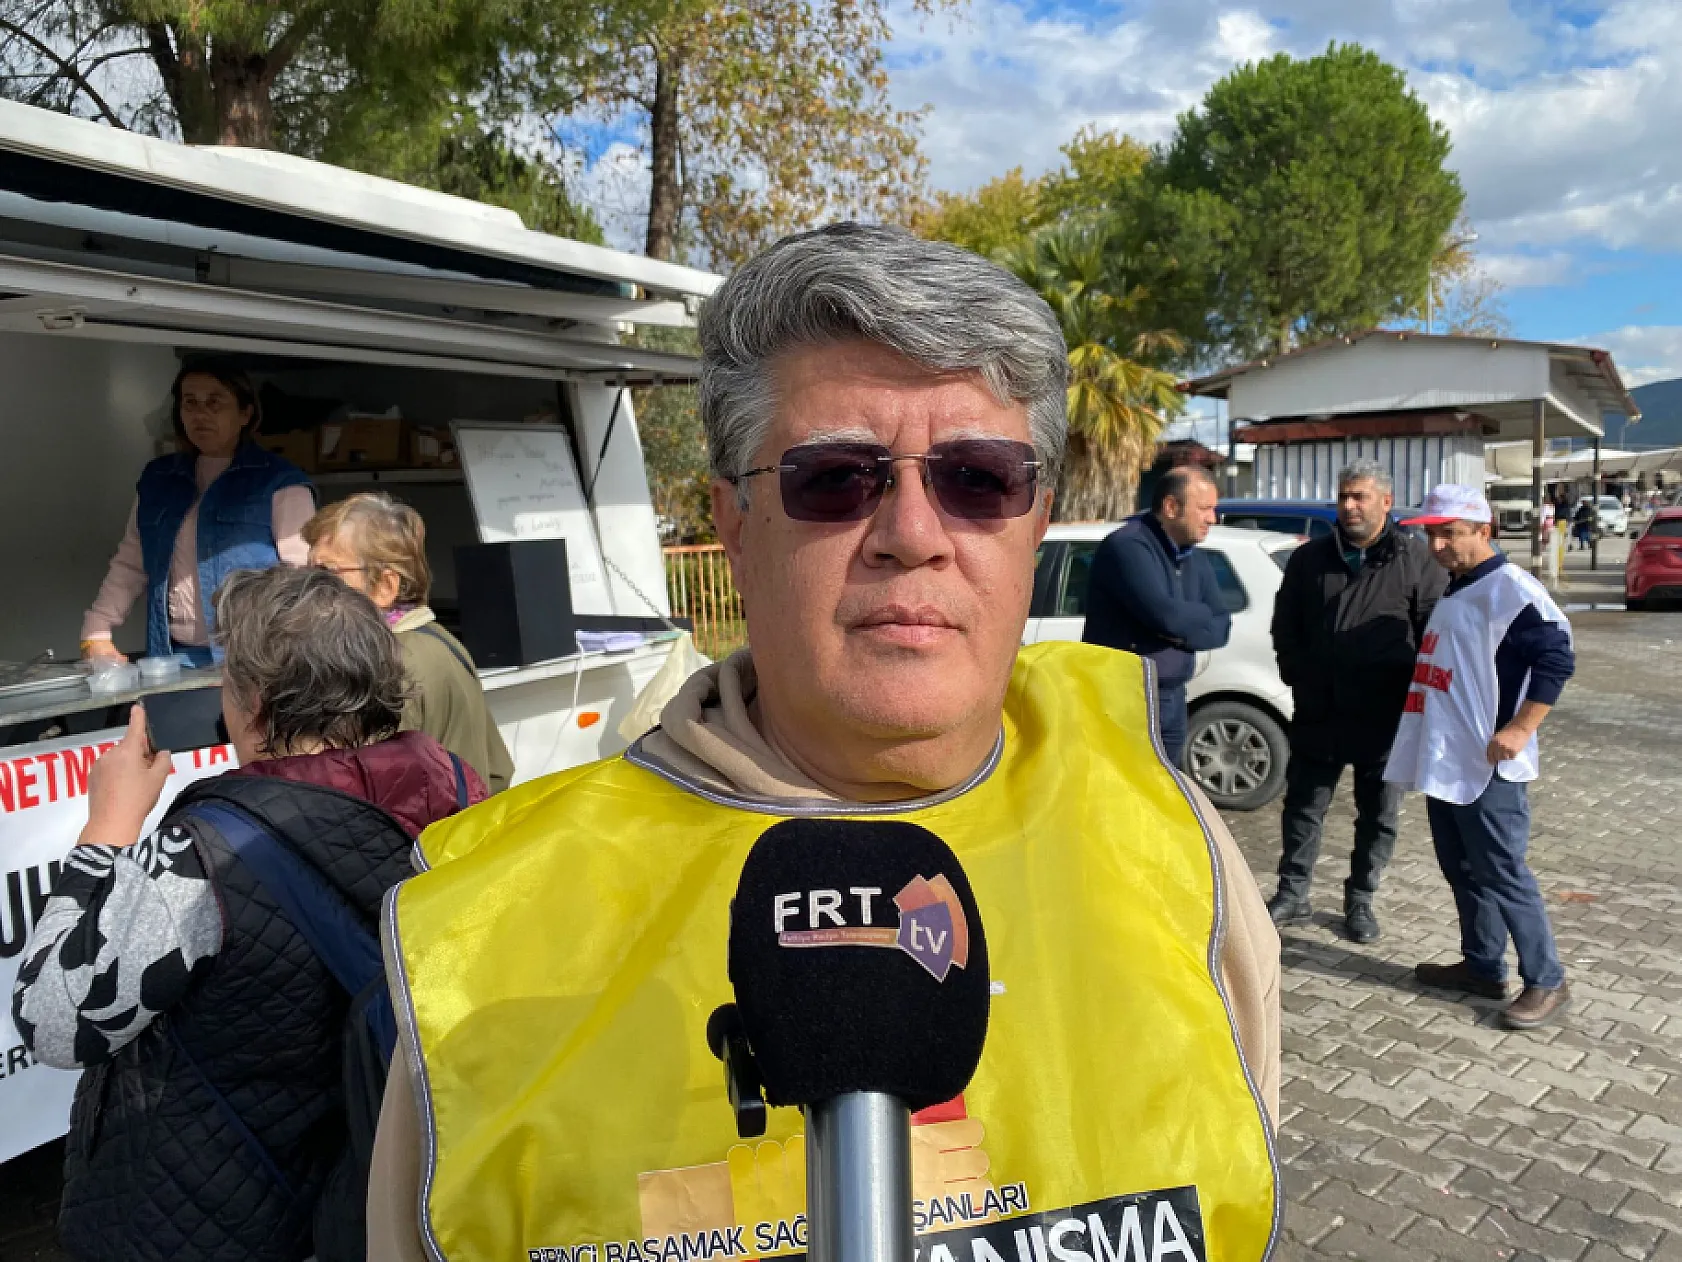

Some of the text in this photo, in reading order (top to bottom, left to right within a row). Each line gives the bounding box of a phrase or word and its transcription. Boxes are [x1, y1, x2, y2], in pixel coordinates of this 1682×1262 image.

[774, 886, 882, 933] FRT
[910, 917, 947, 955] tv
[603, 1226, 748, 1262] BASAMAK
